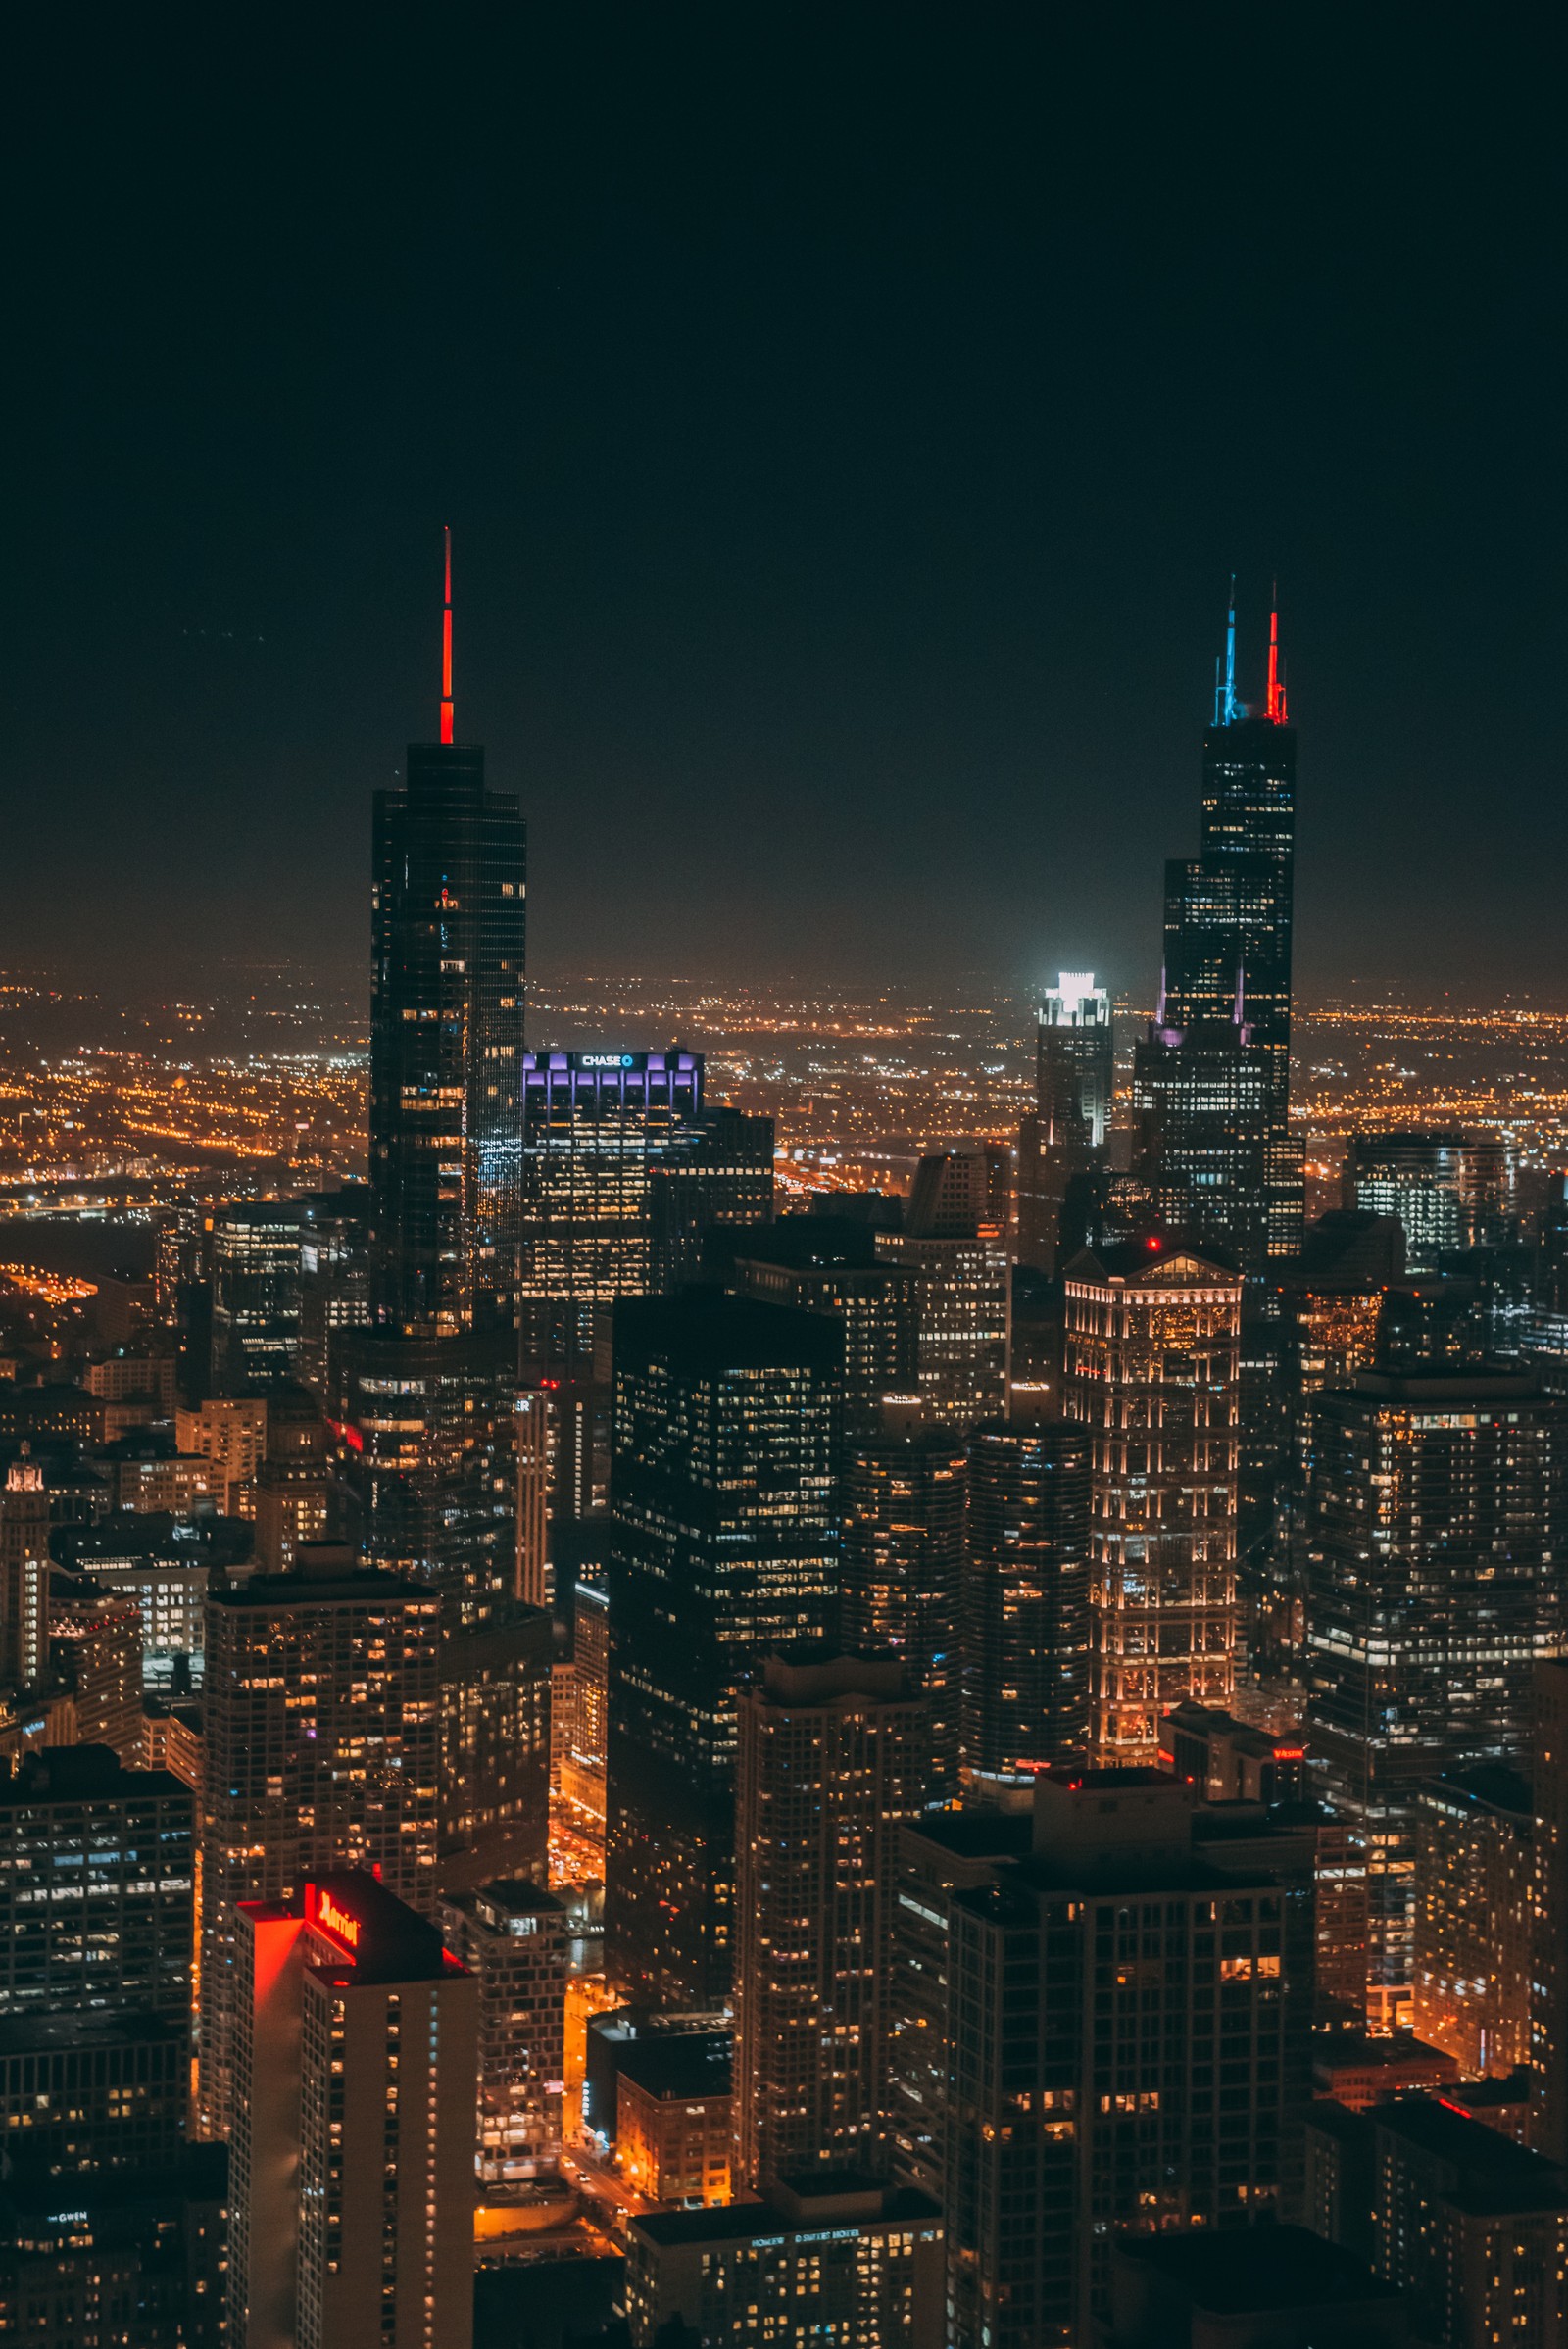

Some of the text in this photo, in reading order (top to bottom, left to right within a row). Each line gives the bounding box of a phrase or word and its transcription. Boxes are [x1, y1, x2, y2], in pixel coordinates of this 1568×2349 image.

[582, 1055, 622, 1066] CHASE
[59, 2211, 88, 2223] GWEN
[832, 2228, 859, 2239] HOTEL
